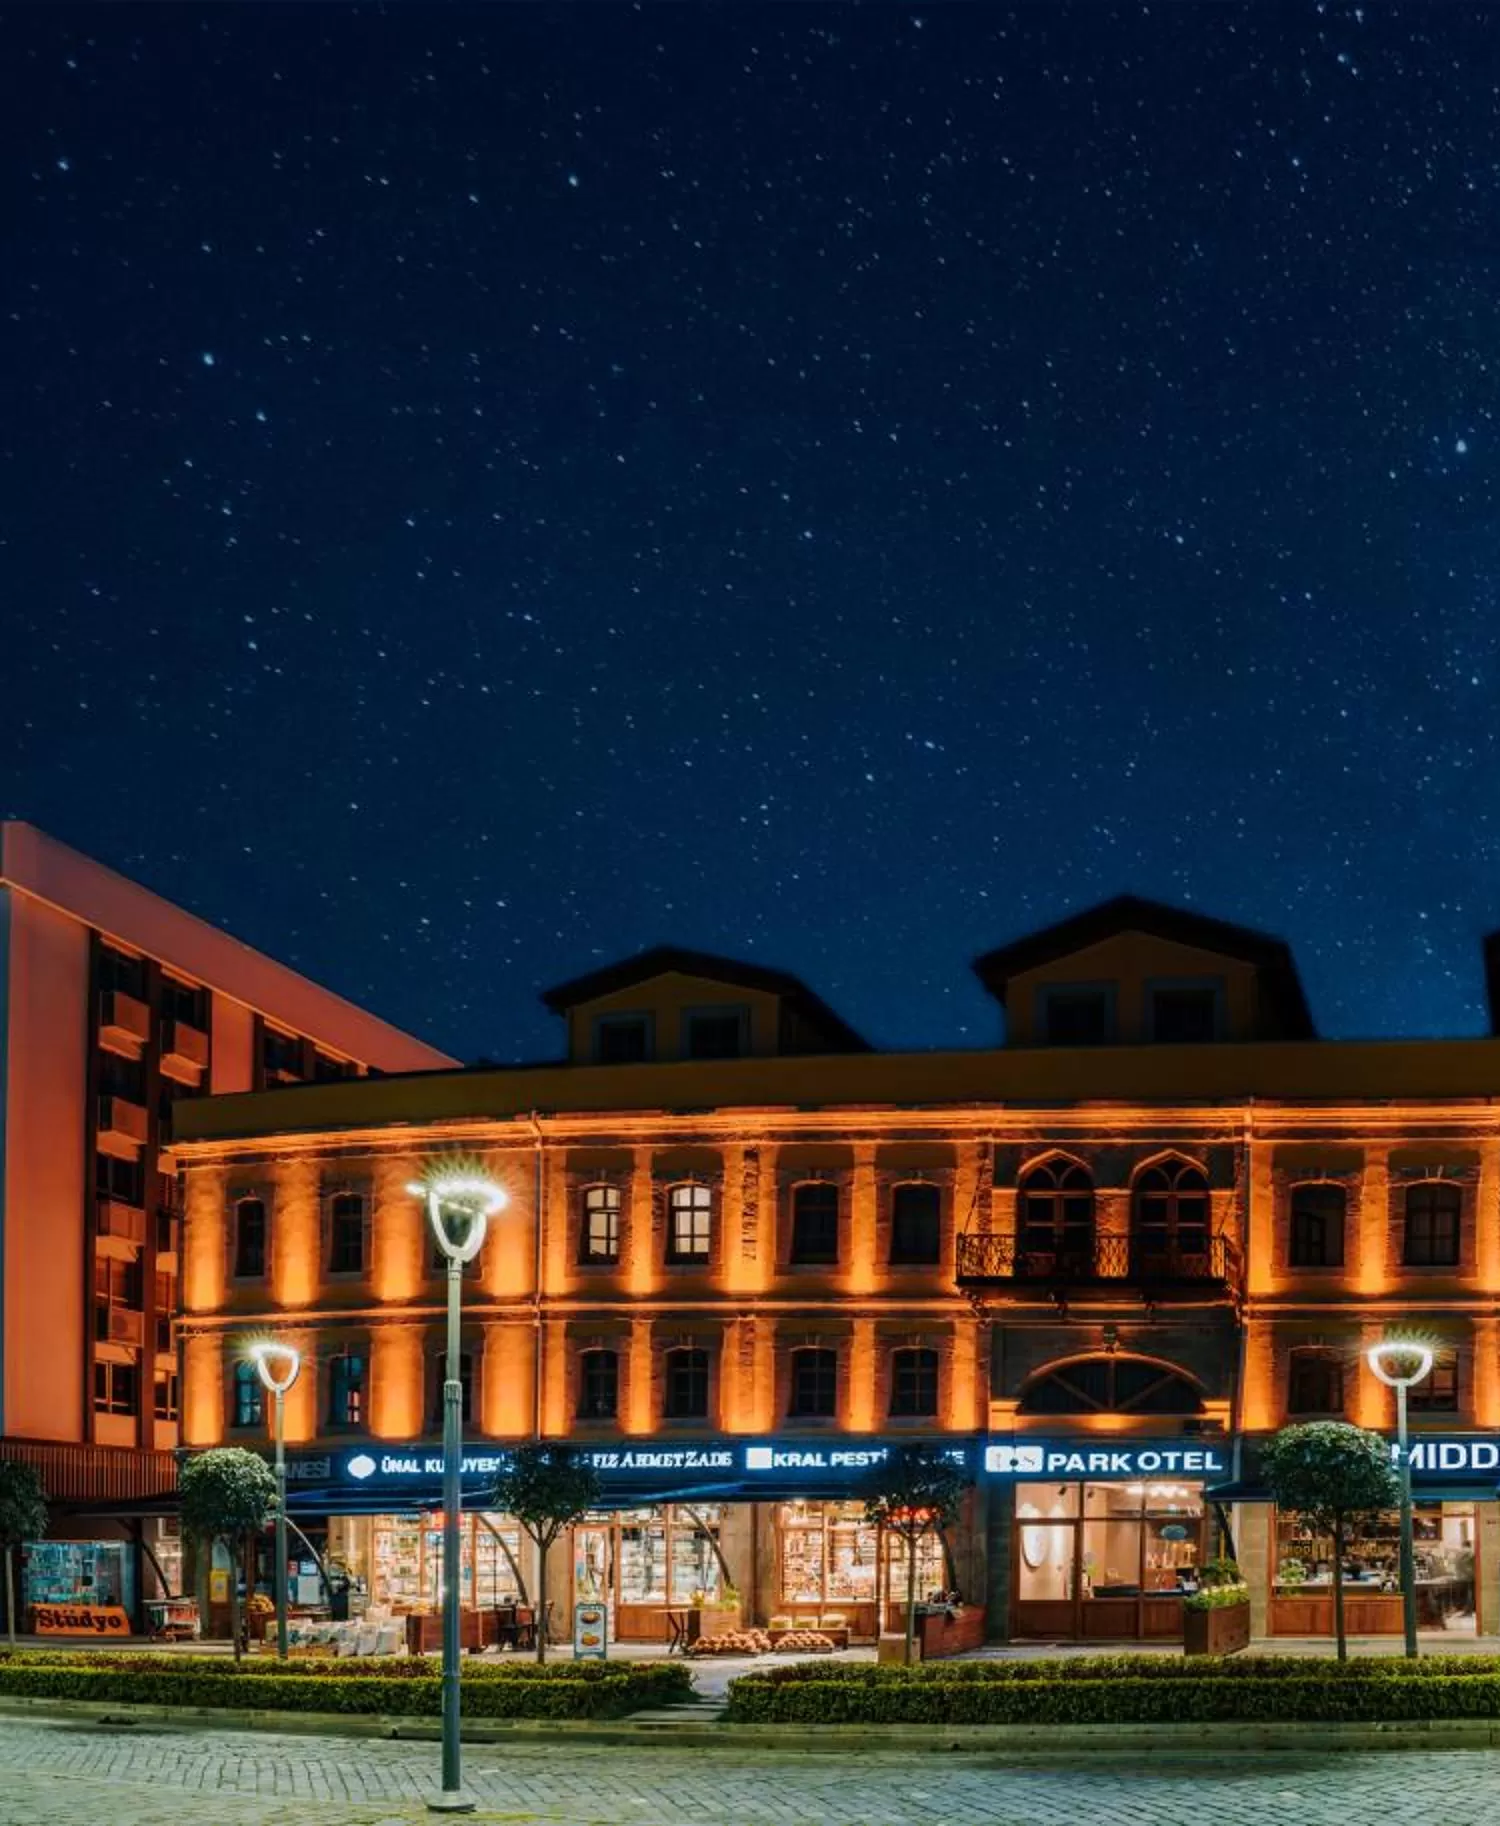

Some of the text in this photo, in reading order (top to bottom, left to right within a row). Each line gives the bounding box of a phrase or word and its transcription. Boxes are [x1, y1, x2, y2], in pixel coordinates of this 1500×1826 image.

[381, 1454, 422, 1473] ÜNAL
[774, 1452, 828, 1467] KRAL
[1048, 1453, 1133, 1472] PARK
[1137, 1451, 1223, 1470] OTEL
[38, 1609, 122, 1632] Stüdyo
